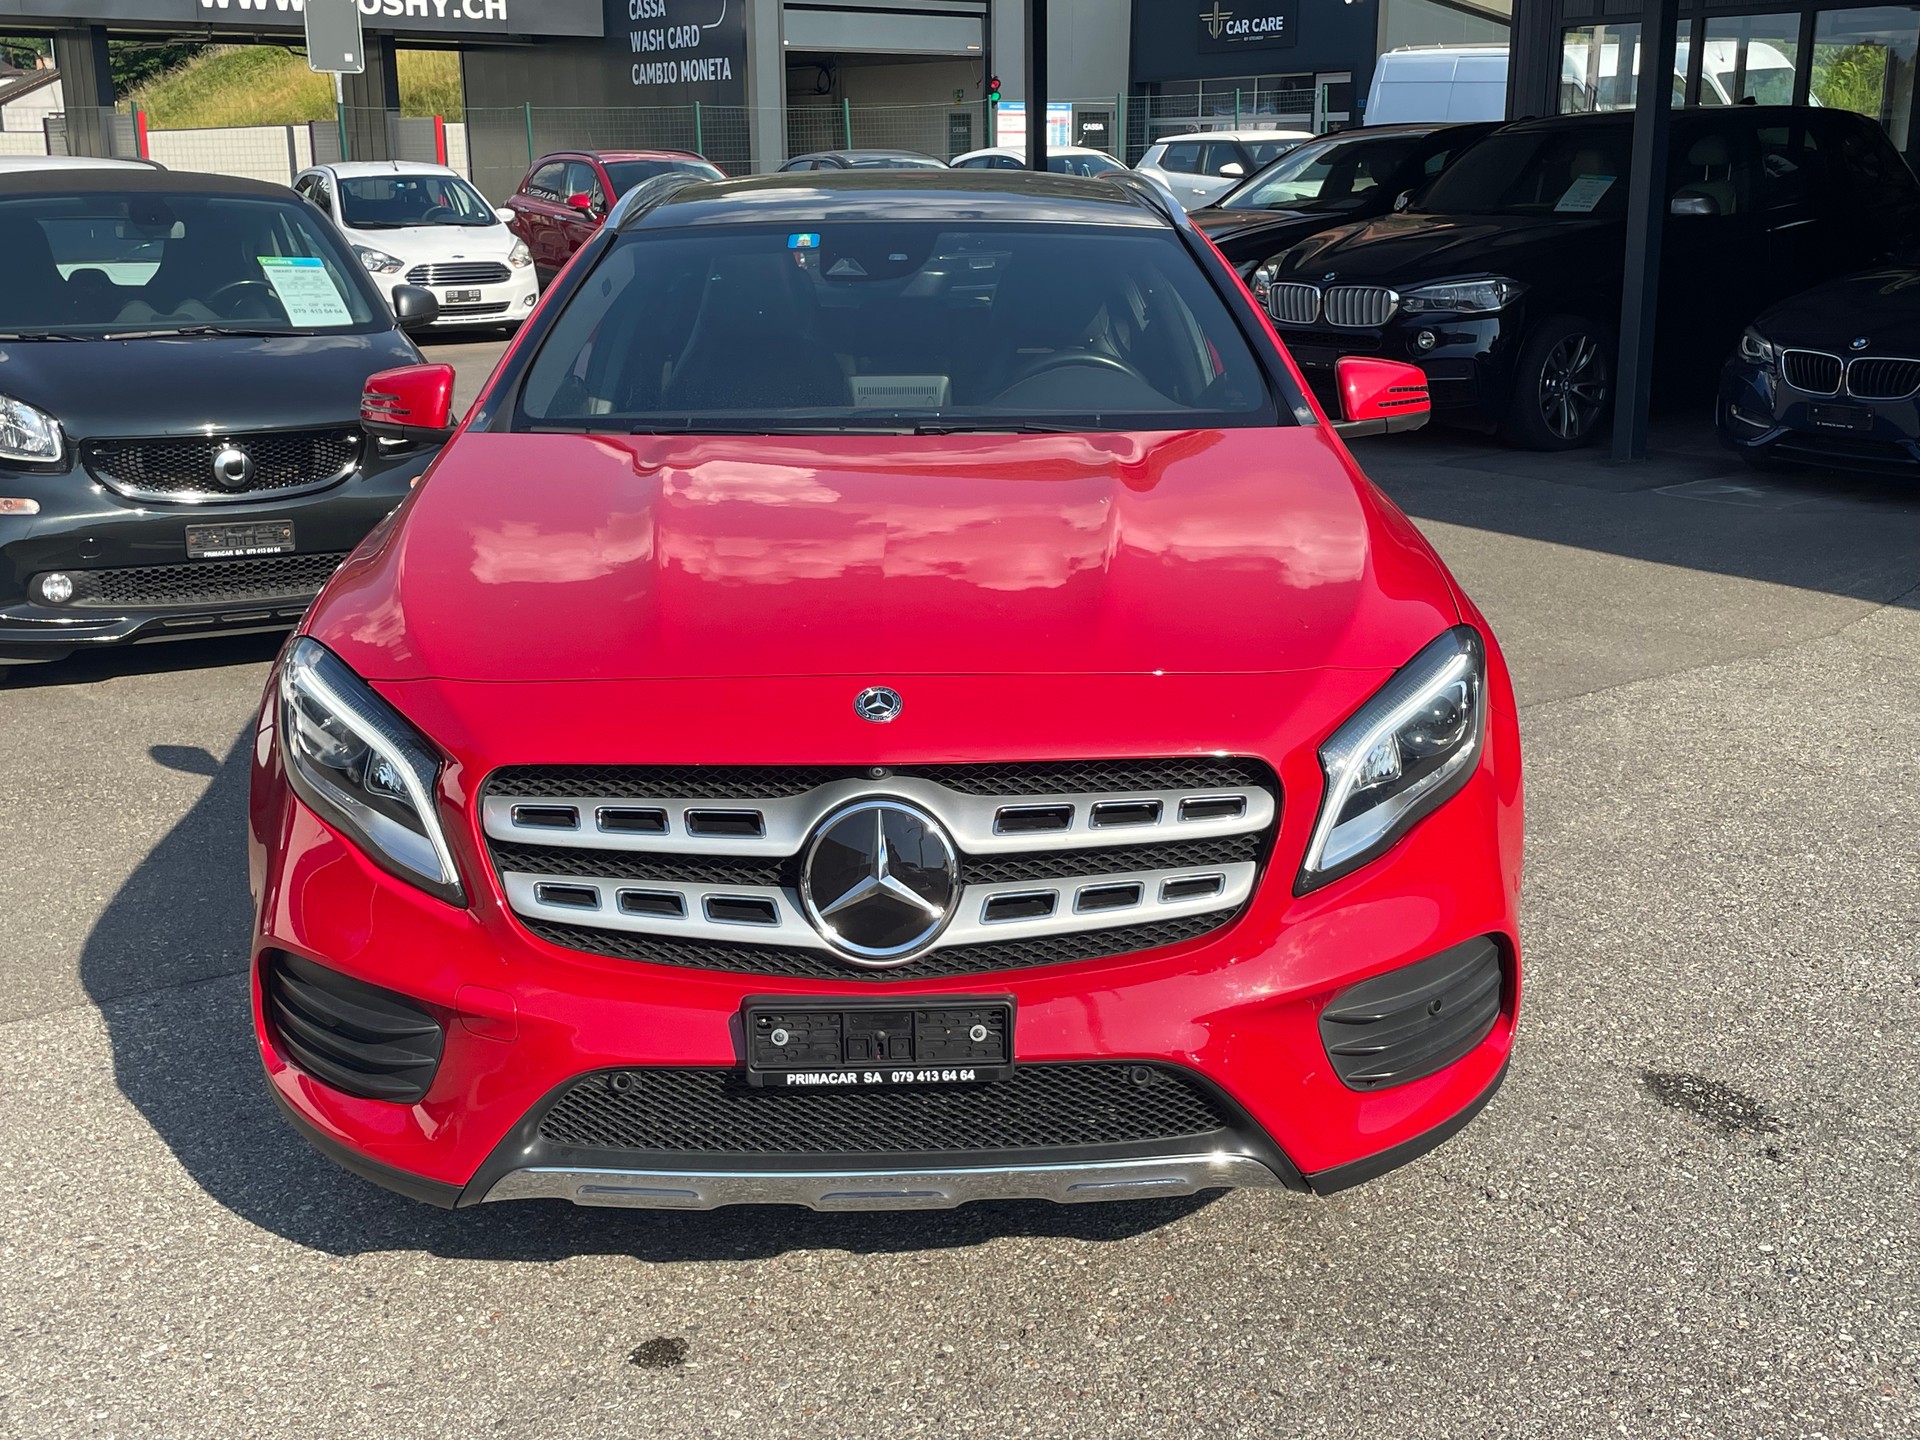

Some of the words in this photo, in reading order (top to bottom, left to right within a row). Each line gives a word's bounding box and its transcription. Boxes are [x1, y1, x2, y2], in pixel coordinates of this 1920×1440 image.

[629, 0, 666, 20] CASSA
[1226, 19, 1250, 35] CAR
[1252, 16, 1284, 32] CARE
[630, 28, 665, 53] WASH
[667, 24, 700, 50] CARD
[631, 61, 678, 85] CAMBIO
[680, 57, 732, 82] MONETA
[1082, 123, 1104, 131] CASSA
[203, 550, 234, 558] PRIMACAR
[235, 548, 244, 556] SA
[786, 1073, 857, 1085] PRIMACAR
[863, 1073, 882, 1083] SA
[891, 1071, 914, 1083] 079
[917, 1071, 939, 1082] 413
[942, 1070, 957, 1081] 64
[960, 1070, 976, 1081] 64
